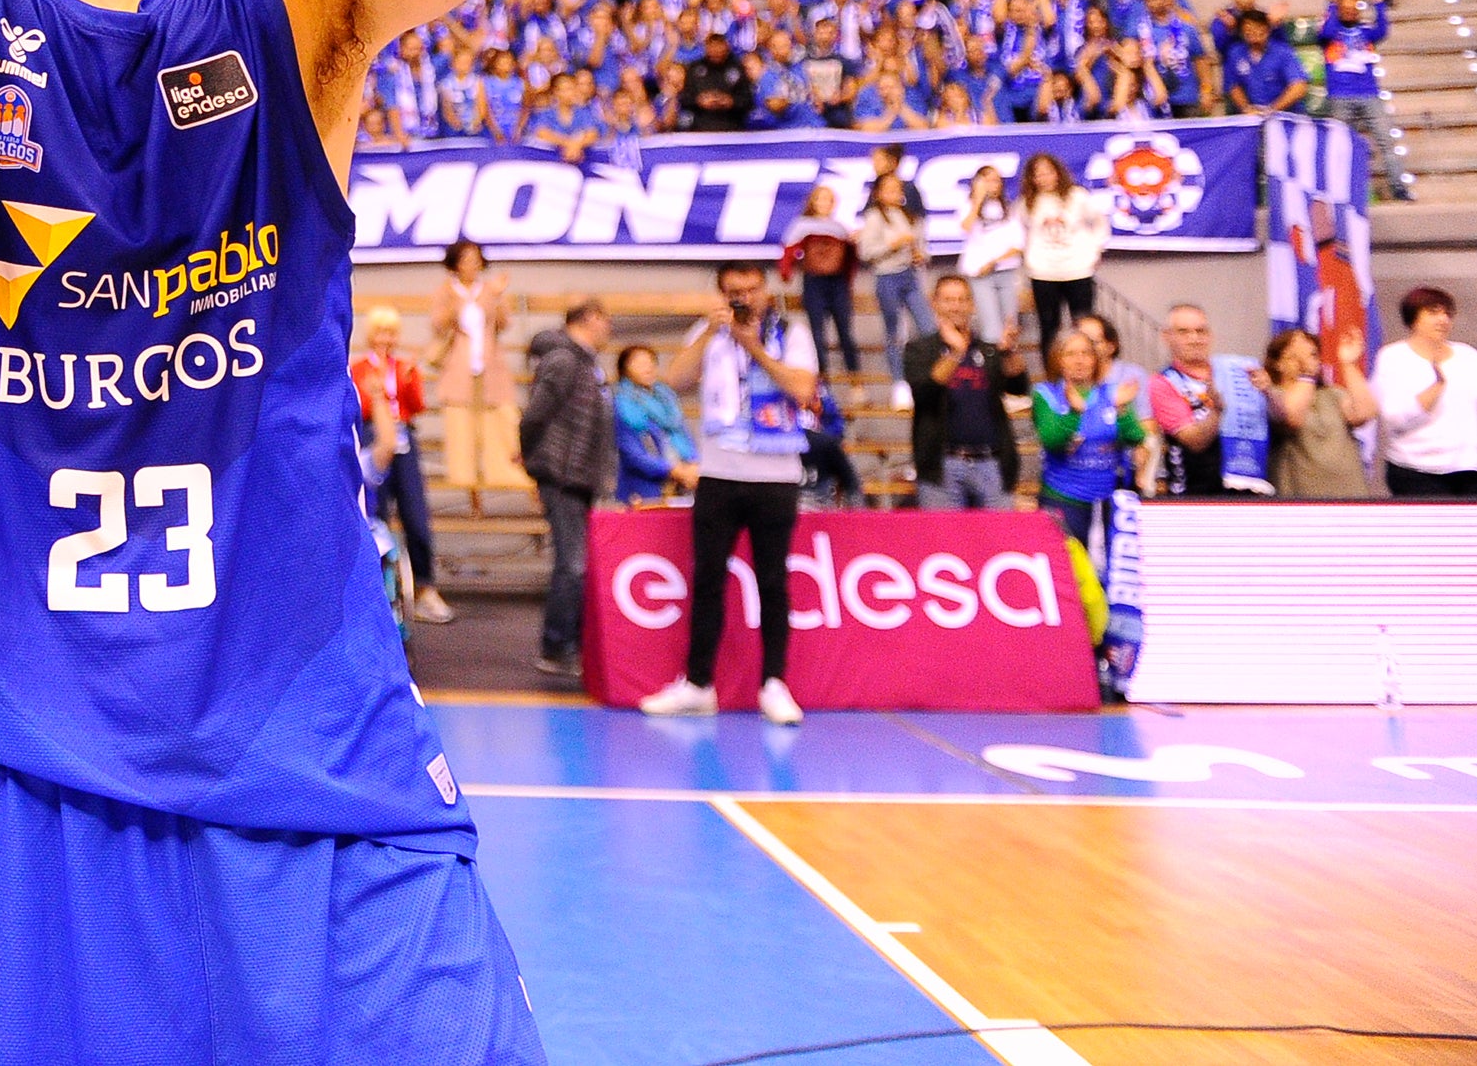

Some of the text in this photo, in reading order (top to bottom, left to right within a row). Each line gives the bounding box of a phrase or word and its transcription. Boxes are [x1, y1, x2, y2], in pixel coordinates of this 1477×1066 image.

[171, 85, 205, 105] liga
[177, 86, 249, 120] endesa
[47, 464, 217, 614] 23
